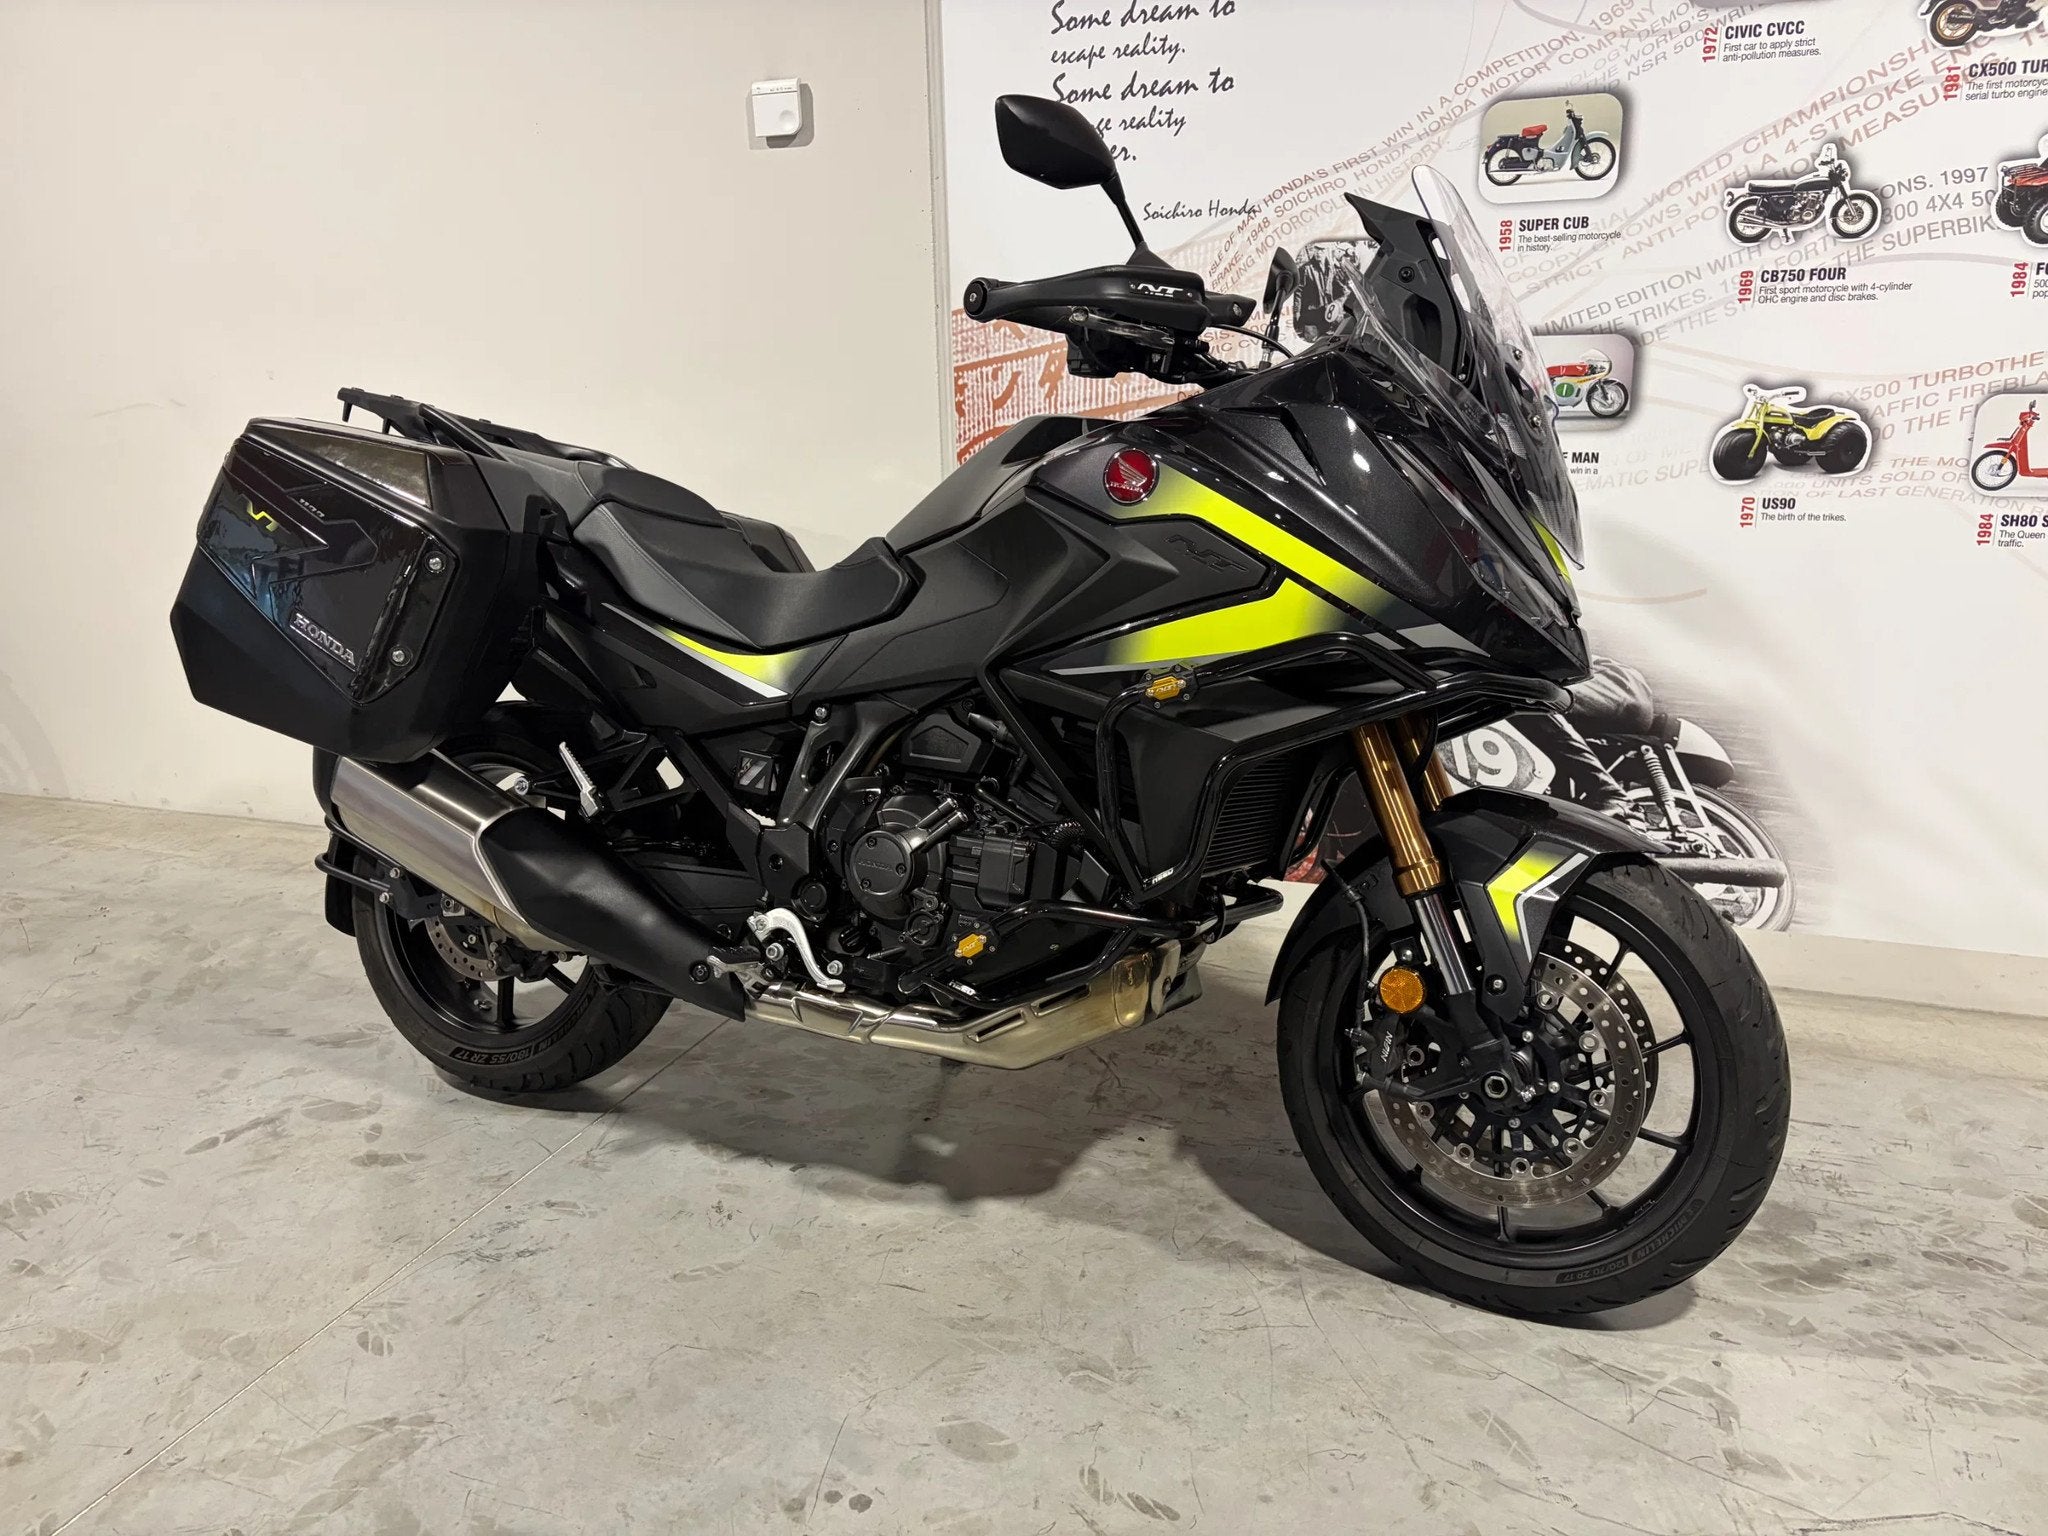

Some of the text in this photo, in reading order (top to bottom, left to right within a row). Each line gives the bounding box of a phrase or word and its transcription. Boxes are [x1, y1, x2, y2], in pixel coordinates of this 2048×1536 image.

[1051, 0, 1235, 34] Some dream to
[1637, 0, 1695, 42] DEMO
[1725, 20, 1805, 40] CIVIC CVCC
[1051, 31, 1185, 69] escape reality.
[1625, 9, 1710, 66] WORLD'S
[1702, 27, 1718, 62] 1972
[1723, 38, 1816, 52] First car to apply strict
[1628, 51, 1669, 81] NSR
[1723, 48, 1822, 62] anti-pollution measures.
[1969, 61, 2016, 77] CX500
[1052, 67, 1235, 103] Some dream to
[1943, 66, 1960, 101] 1981
[1965, 92, 1989, 101] serial
[1991, 90, 2015, 99] turbo
[1967, 81, 1983, 90] The
[1986, 80, 2003, 89] first
[1119, 106, 1187, 136] reality
[1246, 217, 1271, 246] 1948
[1275, 177, 1347, 218] SOICHIRO
[1353, 141, 1412, 181] HONDA
[1417, 98, 1476, 142] HONDA
[1481, 60, 1551, 98] MOTOR
[1559, 0, 1657, 65] COMPANY
[1643, 151, 1733, 206] WORLD
[1742, 37, 1936, 154] CHAMPIONSH
[1687, 163, 1751, 209] WITH
[1759, 153, 1779, 171] A
[1785, 68, 1924, 155] 4-STROKE
[1208, 251, 1224, 277] ISLE
[1224, 231, 1236, 252] OF
[1237, 204, 1262, 234] MAN
[1263, 167, 1329, 208] HONDA'S
[1332, 145, 1379, 178] FIRST
[1382, 120, 1414, 148] WIN
[1416, 105, 1435, 124] IN
[1438, 94, 1452, 110] A
[1453, 30, 1585, 97] COMPETITION.
[1143, 198, 1258, 221] Soichiro Honda
[1499, 220, 1512, 251] 1958
[1519, 217, 1559, 231] SUPER
[1563, 216, 1590, 230] CUB
[1617, 267, 1702, 308] EDITION
[1706, 242, 1762, 275] WITH
[1941, 166, 1989, 186] 1997
[1519, 231, 1621, 244] The best-selling motorcycle
[1526, 243, 1552, 253] history.
[1638, 286, 1713, 328] TRIKES.
[1926, 192, 1964, 213] 4X4
[1526, 256, 1606, 295] STRICT
[1672, 308, 1718, 333] THE
[1833, 240, 1876, 268] THE
[1738, 270, 1754, 303] 1969
[1759, 281, 1913, 296] First sport motorcycle with 4-cylinder
[1761, 267, 1846, 283] CB750 FOUR
[2010, 262, 2029, 297] 1984
[1758, 292, 1878, 304] OHC engine and disc brakes.
[1904, 410, 1952, 434] THE
[1570, 467, 1583, 475] win
[1584, 467, 1592, 475] in
[1572, 452, 1599, 464] MAN
[1891, 456, 1929, 468] THE
[1881, 470, 1938, 485] SOLD
[1762, 497, 1796, 510] US90
[1838, 487, 1893, 498] LAST
[1895, 485, 2026, 512] GENERATION
[1740, 497, 1755, 528] 1970
[1761, 513, 1846, 521] The birth of the trikes.
[2001, 514, 2038, 527] SH80
[1976, 514, 1994, 546] 1984
[1998, 539, 2024, 547] traffic.
[2000, 530, 2046, 539] The Queen
[294, 612, 356, 667] HONDA
